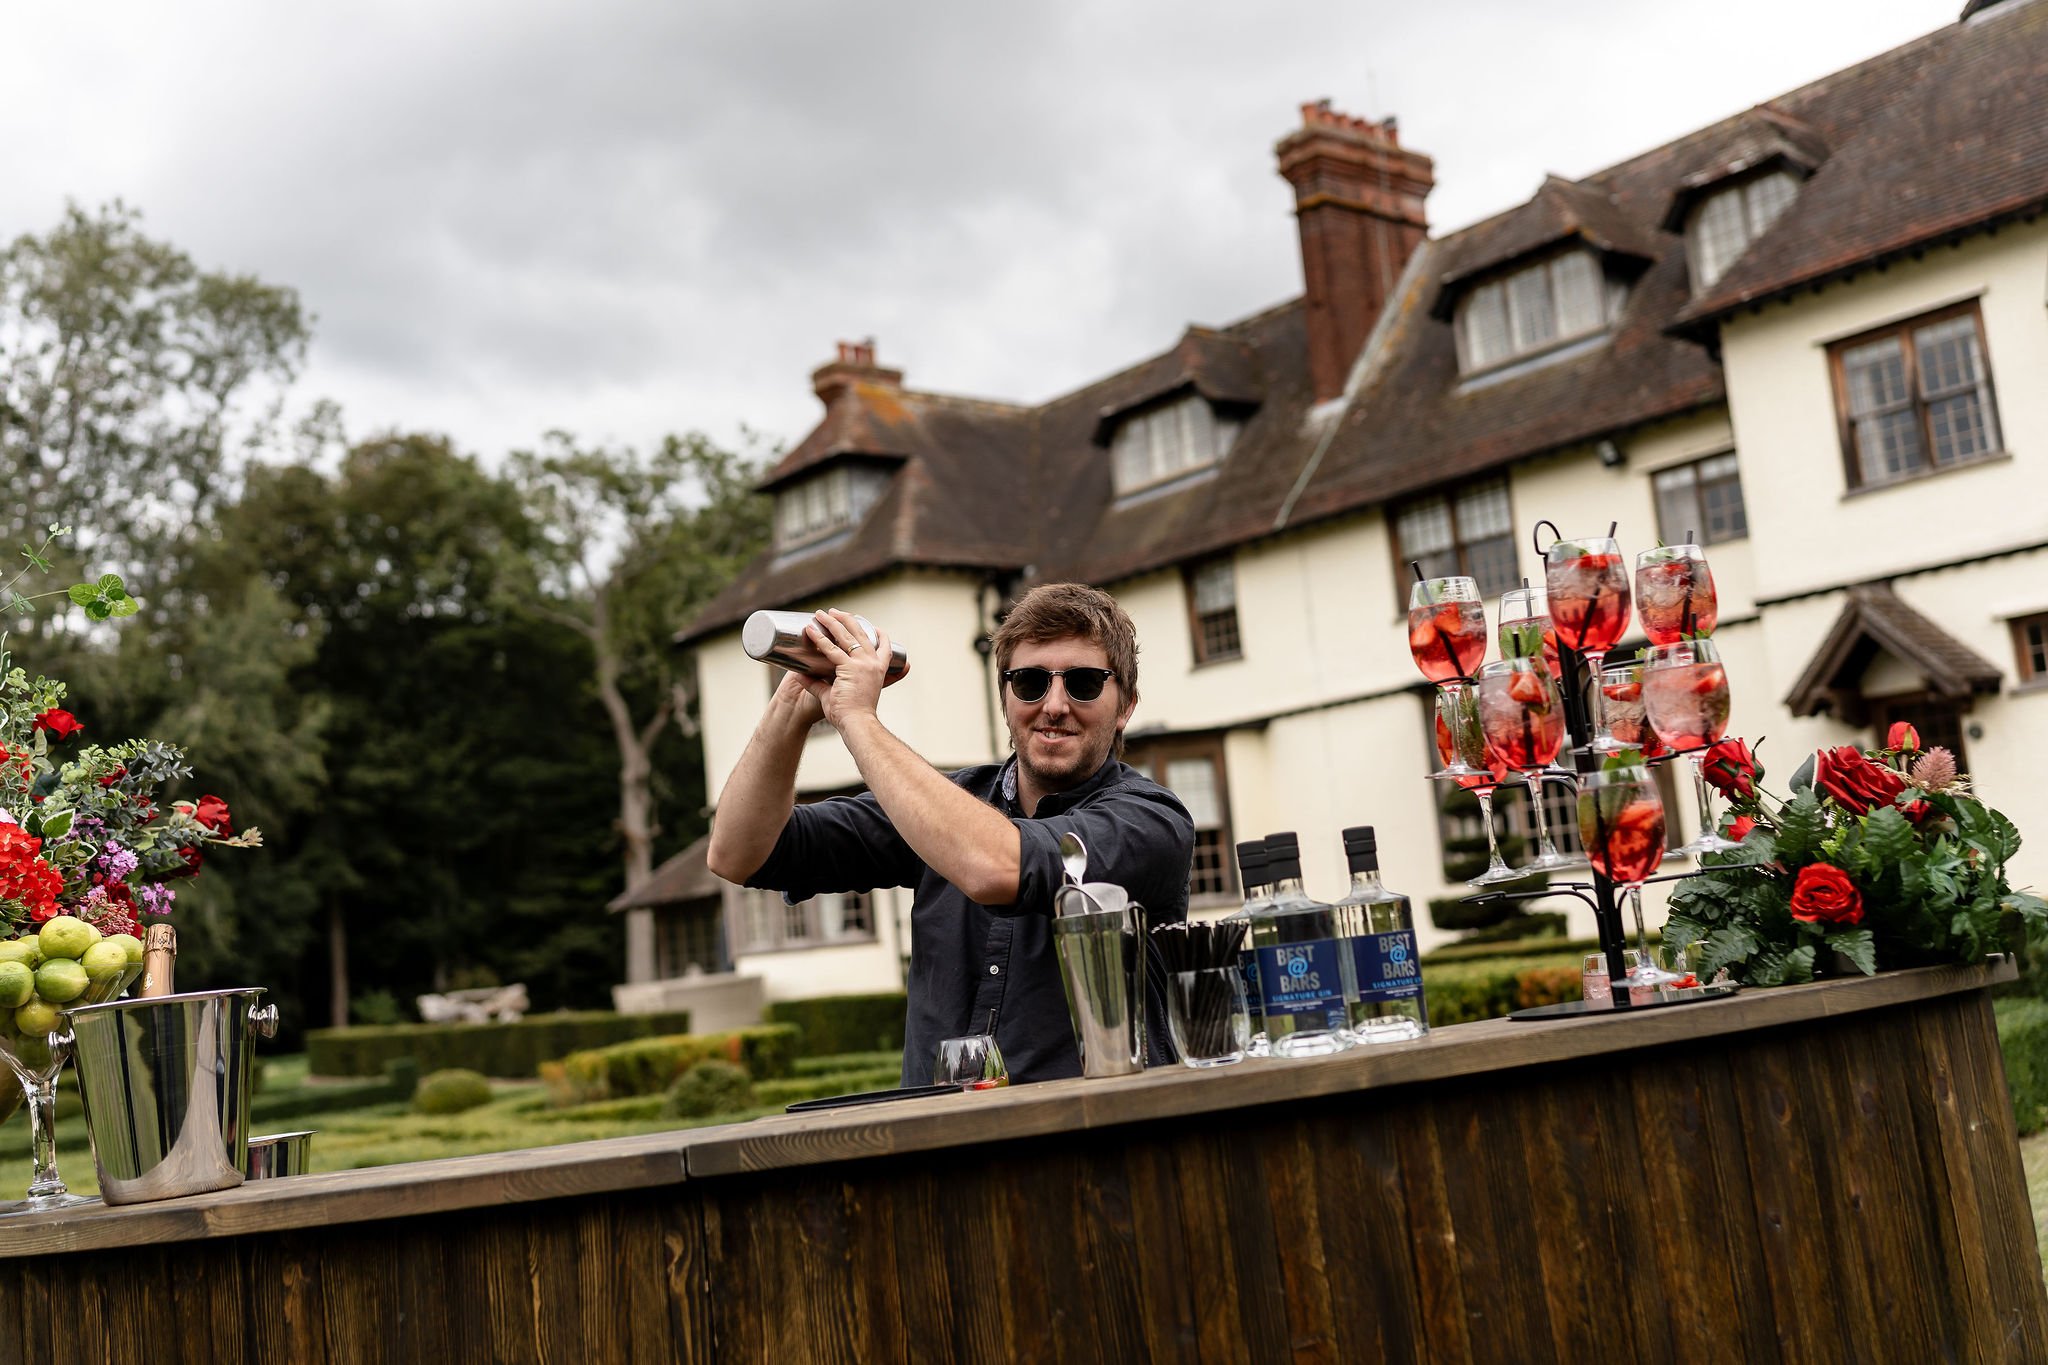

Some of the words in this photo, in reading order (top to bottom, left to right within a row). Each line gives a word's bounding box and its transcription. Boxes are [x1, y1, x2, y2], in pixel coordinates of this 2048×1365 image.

[1378, 933, 1411, 953] BEST
[1276, 945, 1315, 967] BEST
[1390, 944, 1407, 965] @
[1288, 957, 1308, 978] @
[1382, 959, 1416, 979] BARS
[1280, 972, 1320, 993] BARS
[1372, 978, 1412, 989] SIGNATURE
[1272, 992, 1315, 1002] SIGNATURE
[1318, 990, 1332, 998] GIN
